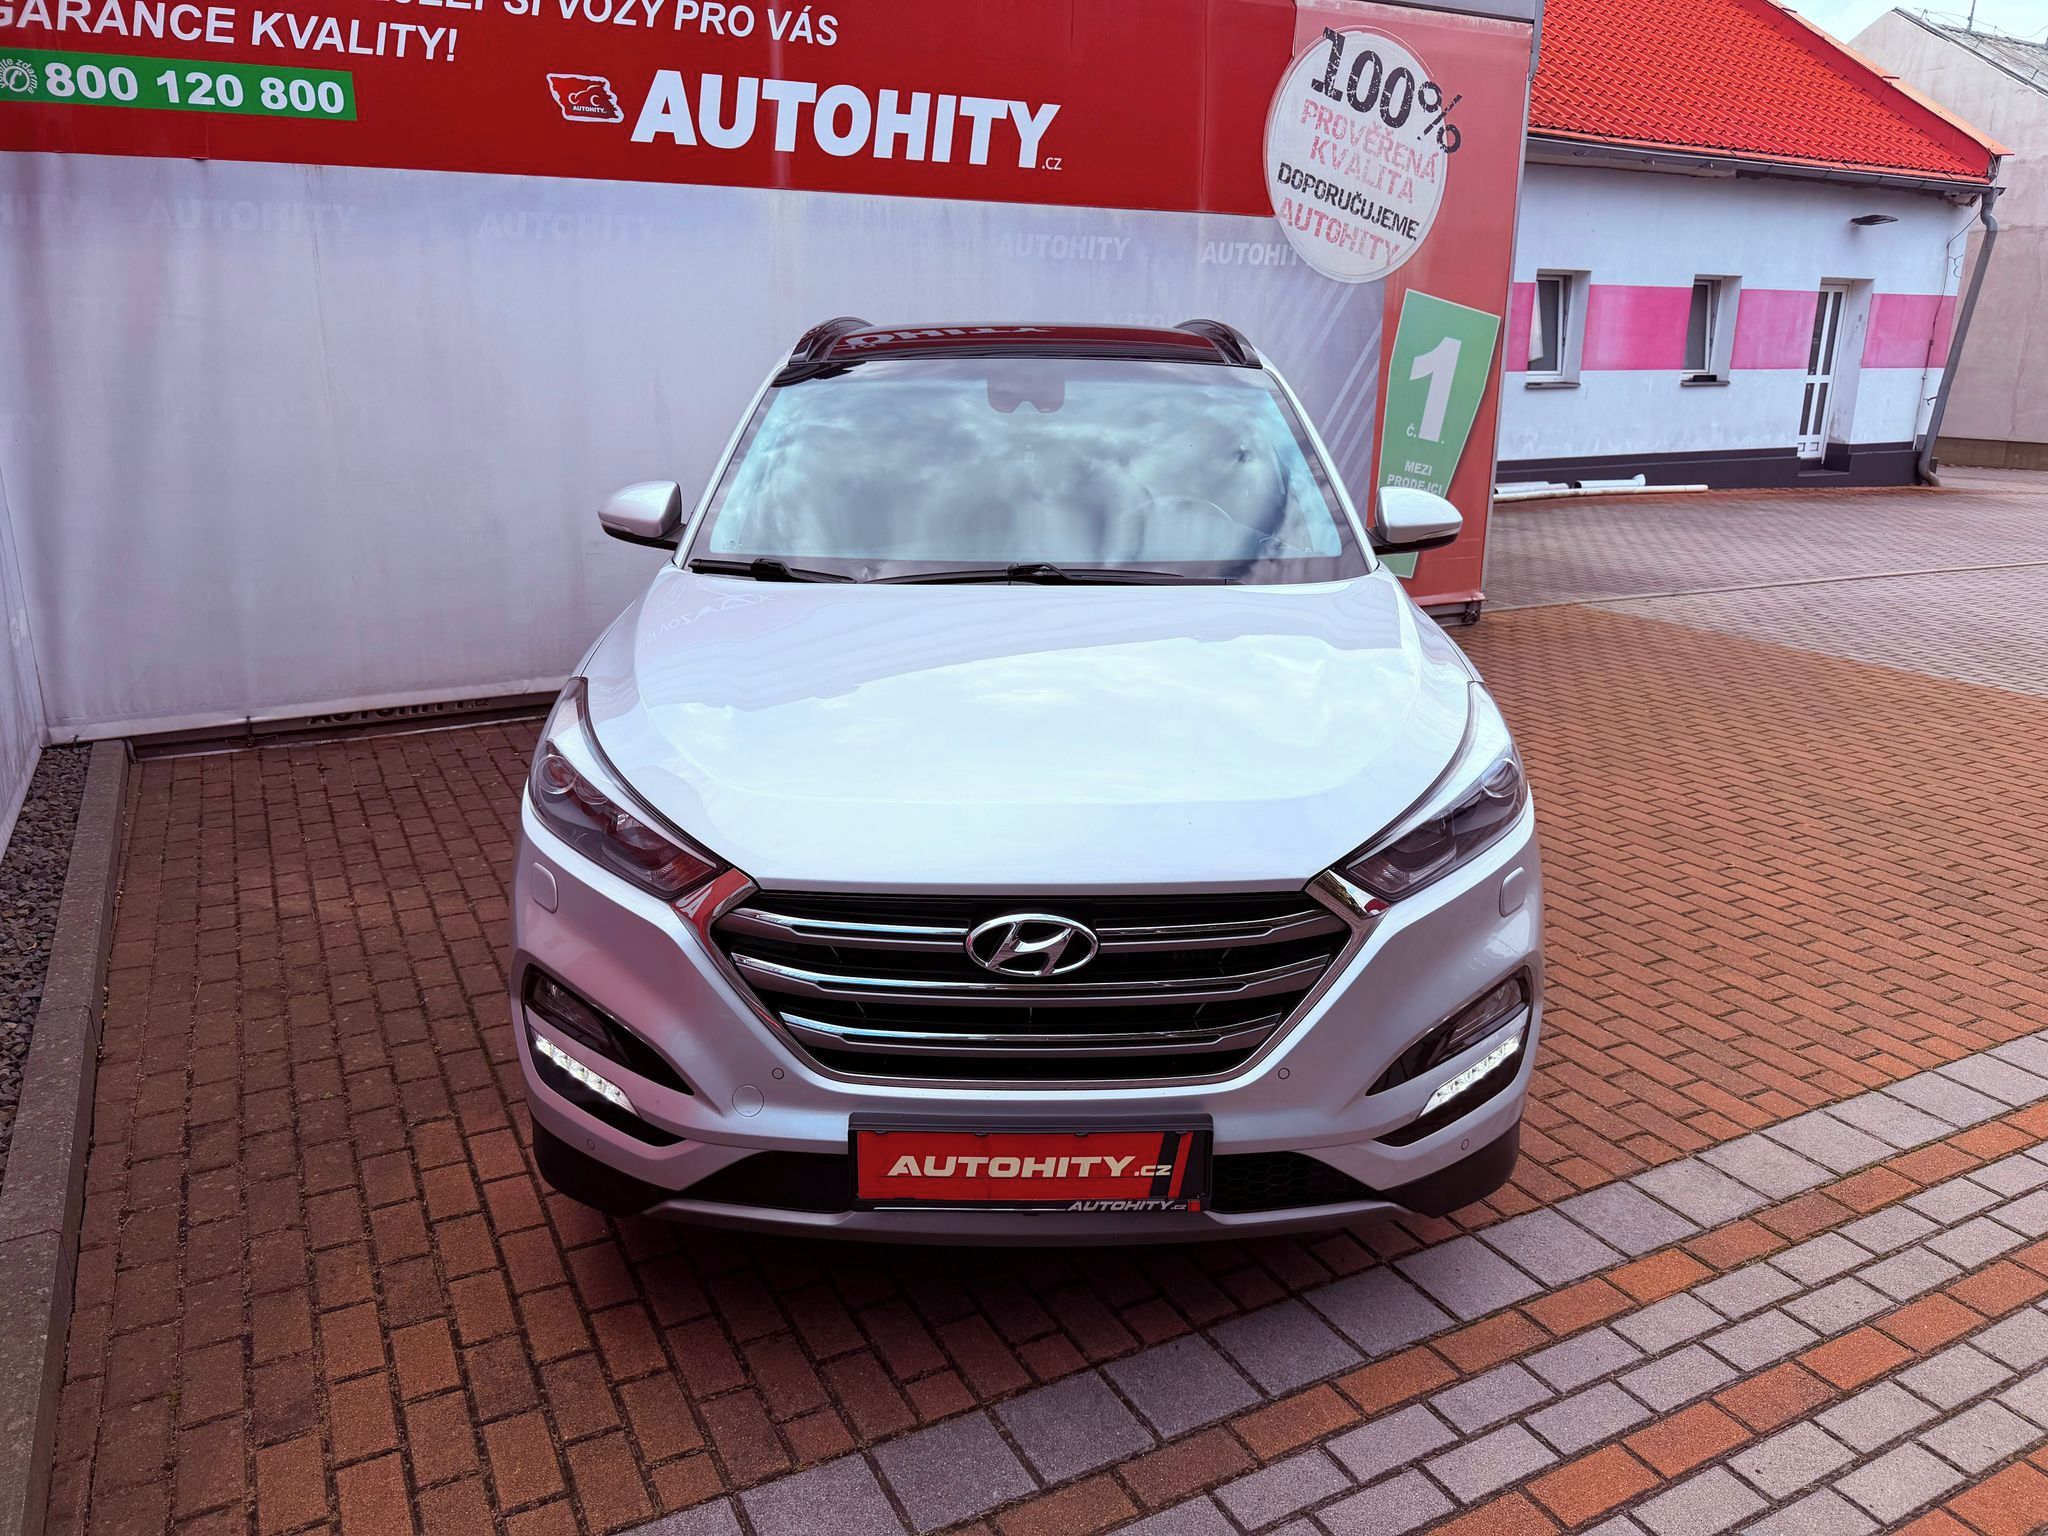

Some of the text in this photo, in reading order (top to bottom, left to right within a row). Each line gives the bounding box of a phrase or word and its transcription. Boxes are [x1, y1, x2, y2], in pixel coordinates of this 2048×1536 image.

[252, 11, 458, 62] KVALITY!
[674, 0, 755, 38] PRO
[767, 5, 839, 46] VÁS
[45, 62, 139, 102] 800
[156, 69, 244, 108] 120
[260, 76, 345, 114] 800
[1311, 27, 1462, 153] 100%
[1310, 136, 1414, 204] KVALITA
[142, 197, 358, 234] AUTOHITY
[477, 207, 655, 243] AUTOHITY
[1277, 162, 1420, 241] DOPORUČUJEME
[998, 233, 1131, 261] AUTOHITY
[1200, 241, 1310, 267] AUTOHIT
[1279, 197, 1400, 267] AUTOHITY
[1404, 460, 1433, 477] MEZI
